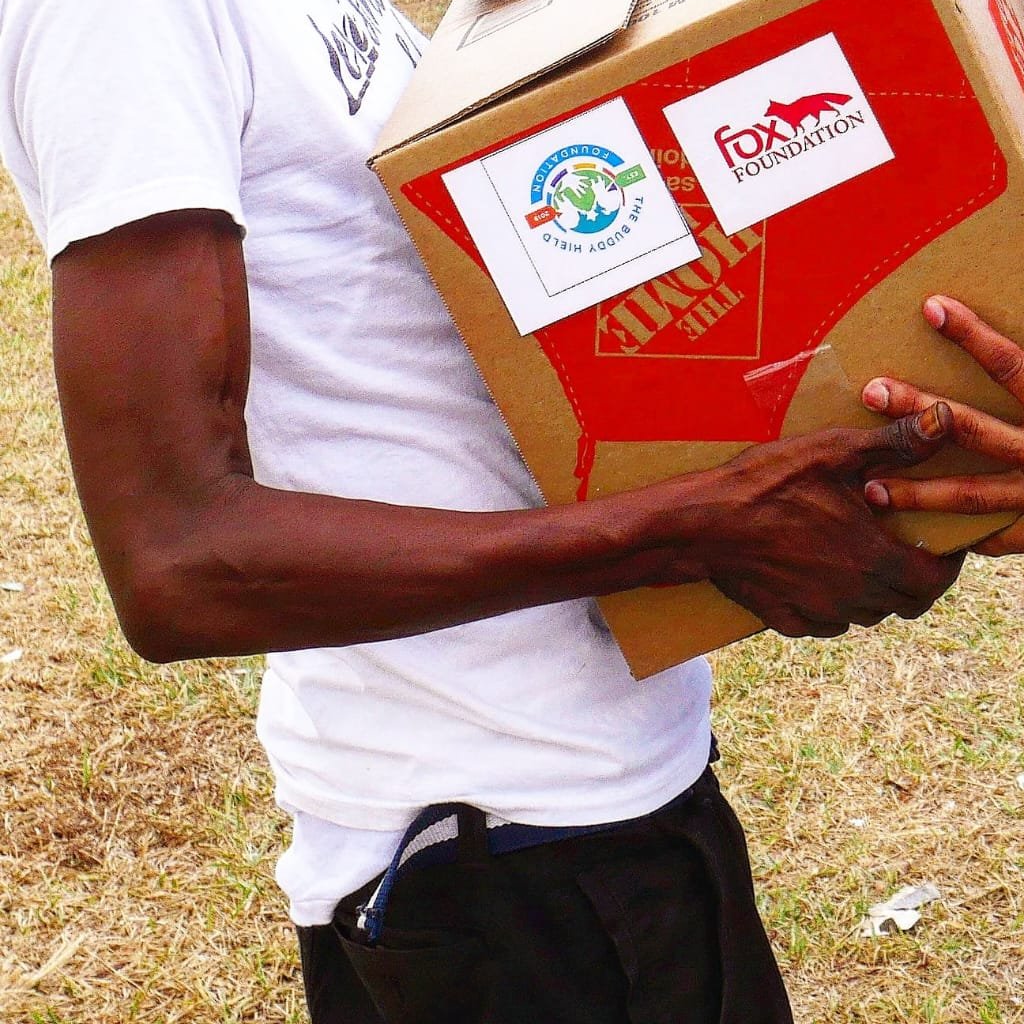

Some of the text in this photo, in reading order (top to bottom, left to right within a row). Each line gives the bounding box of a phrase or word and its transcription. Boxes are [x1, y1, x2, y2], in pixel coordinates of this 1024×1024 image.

[731, 110, 865, 183] FOUNDATION
[531, 145, 611, 193] FOUNDATION
[629, 195, 644, 223] THE
[542, 232, 582, 253] HIELD
[588, 223, 631, 253] BUDDY
[675, 281, 746, 342] THE
